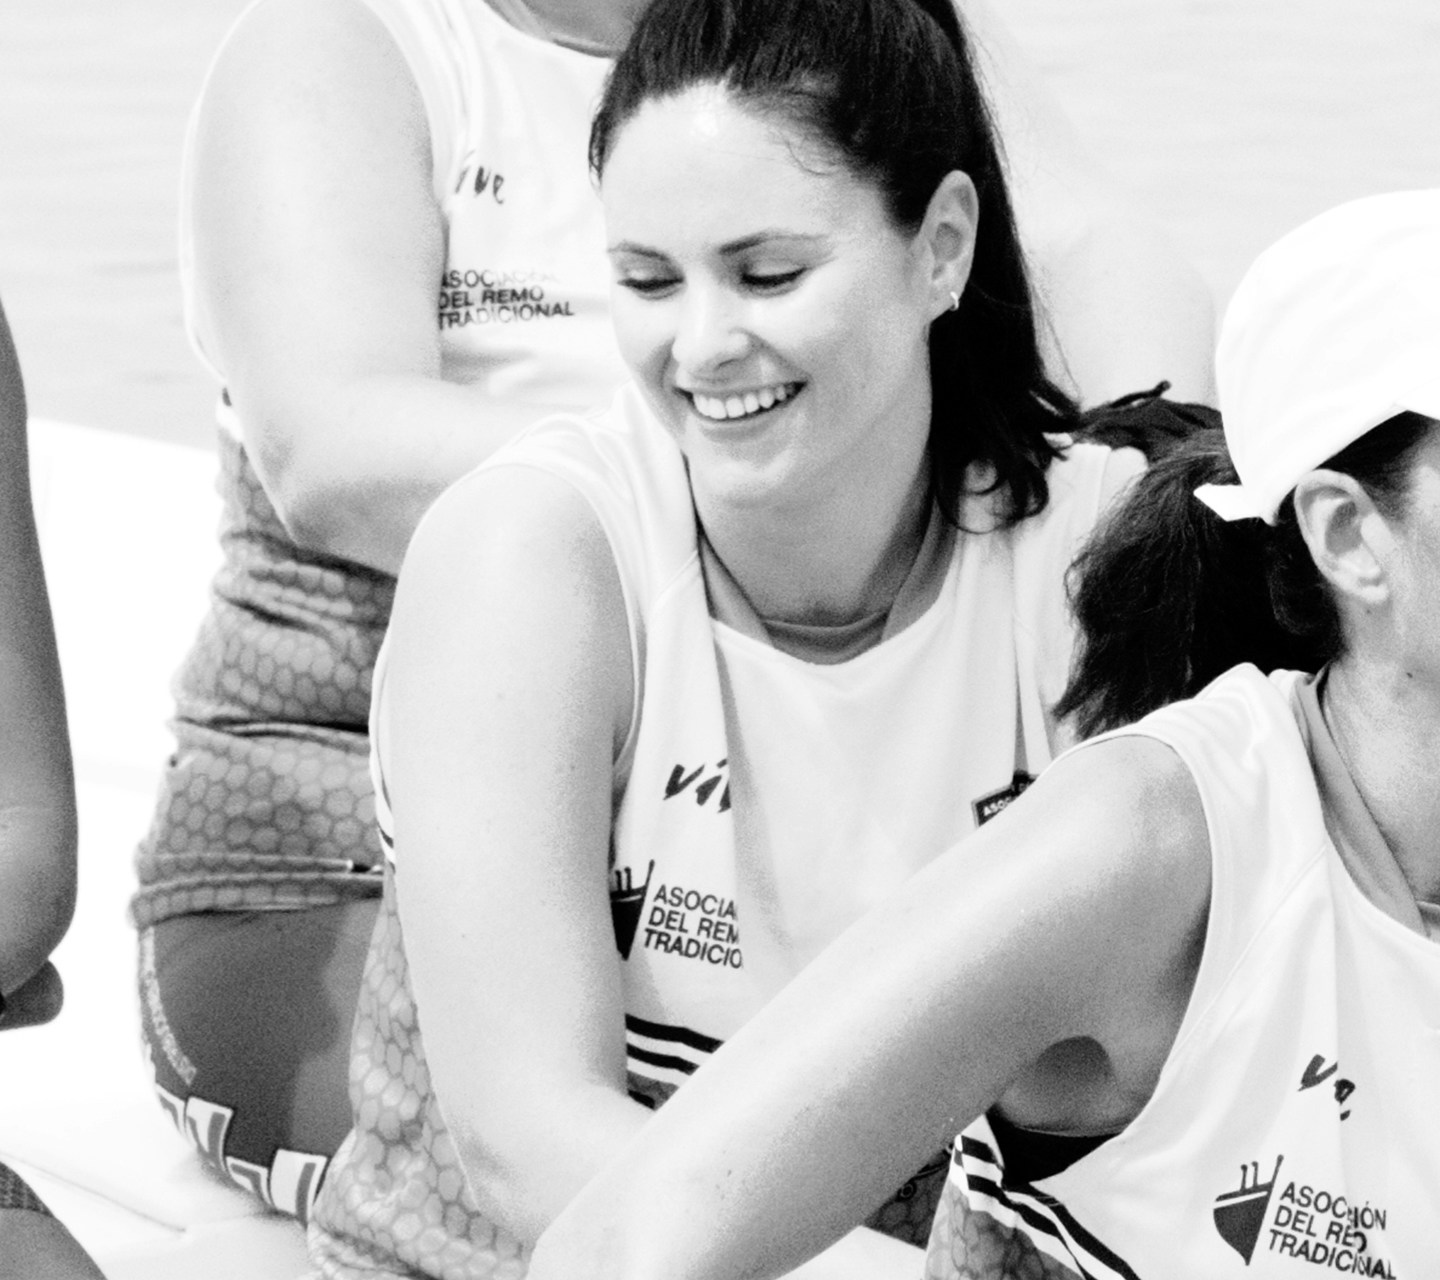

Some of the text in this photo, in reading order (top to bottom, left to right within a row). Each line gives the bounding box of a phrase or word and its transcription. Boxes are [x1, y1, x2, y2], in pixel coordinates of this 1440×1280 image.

[481, 285, 544, 304] REMO
[438, 301, 575, 331] TRADICIONAL
[648, 906, 739, 944] DEL REM
[643, 928, 744, 969] TRADICIO
[1273, 1204, 1317, 1238] DEL
